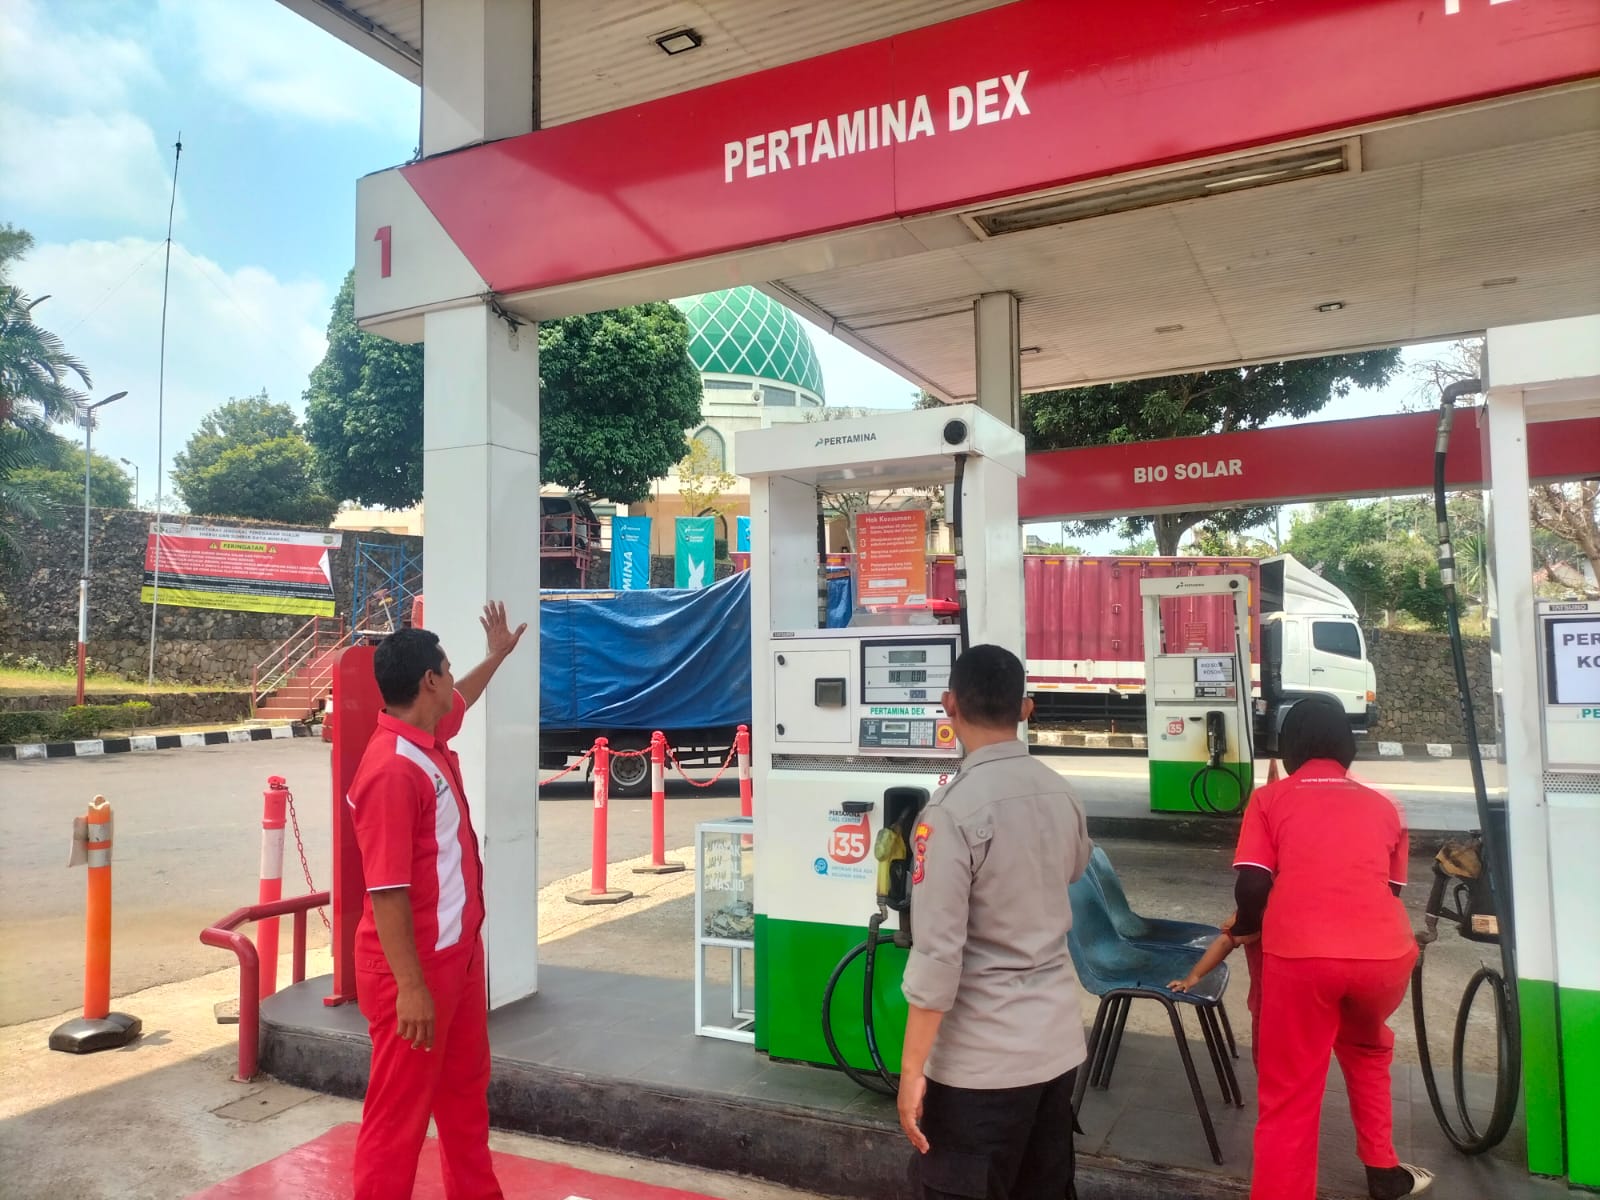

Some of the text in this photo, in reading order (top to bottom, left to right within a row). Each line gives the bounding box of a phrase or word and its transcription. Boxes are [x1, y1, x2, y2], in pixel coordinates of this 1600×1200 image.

[724, 70, 1031, 183] PERTAMINA DEX
[373, 226, 391, 278] 1
[824, 432, 877, 446] PERTAMINA
[1133, 459, 1243, 483] BIO SOLAR
[222, 542, 265, 552] PERINGATAN
[870, 707, 926, 716] PERTAMINA DEX
[1168, 723, 1182, 734] 135
[938, 774, 948, 785] 8
[829, 831, 865, 858] 135
